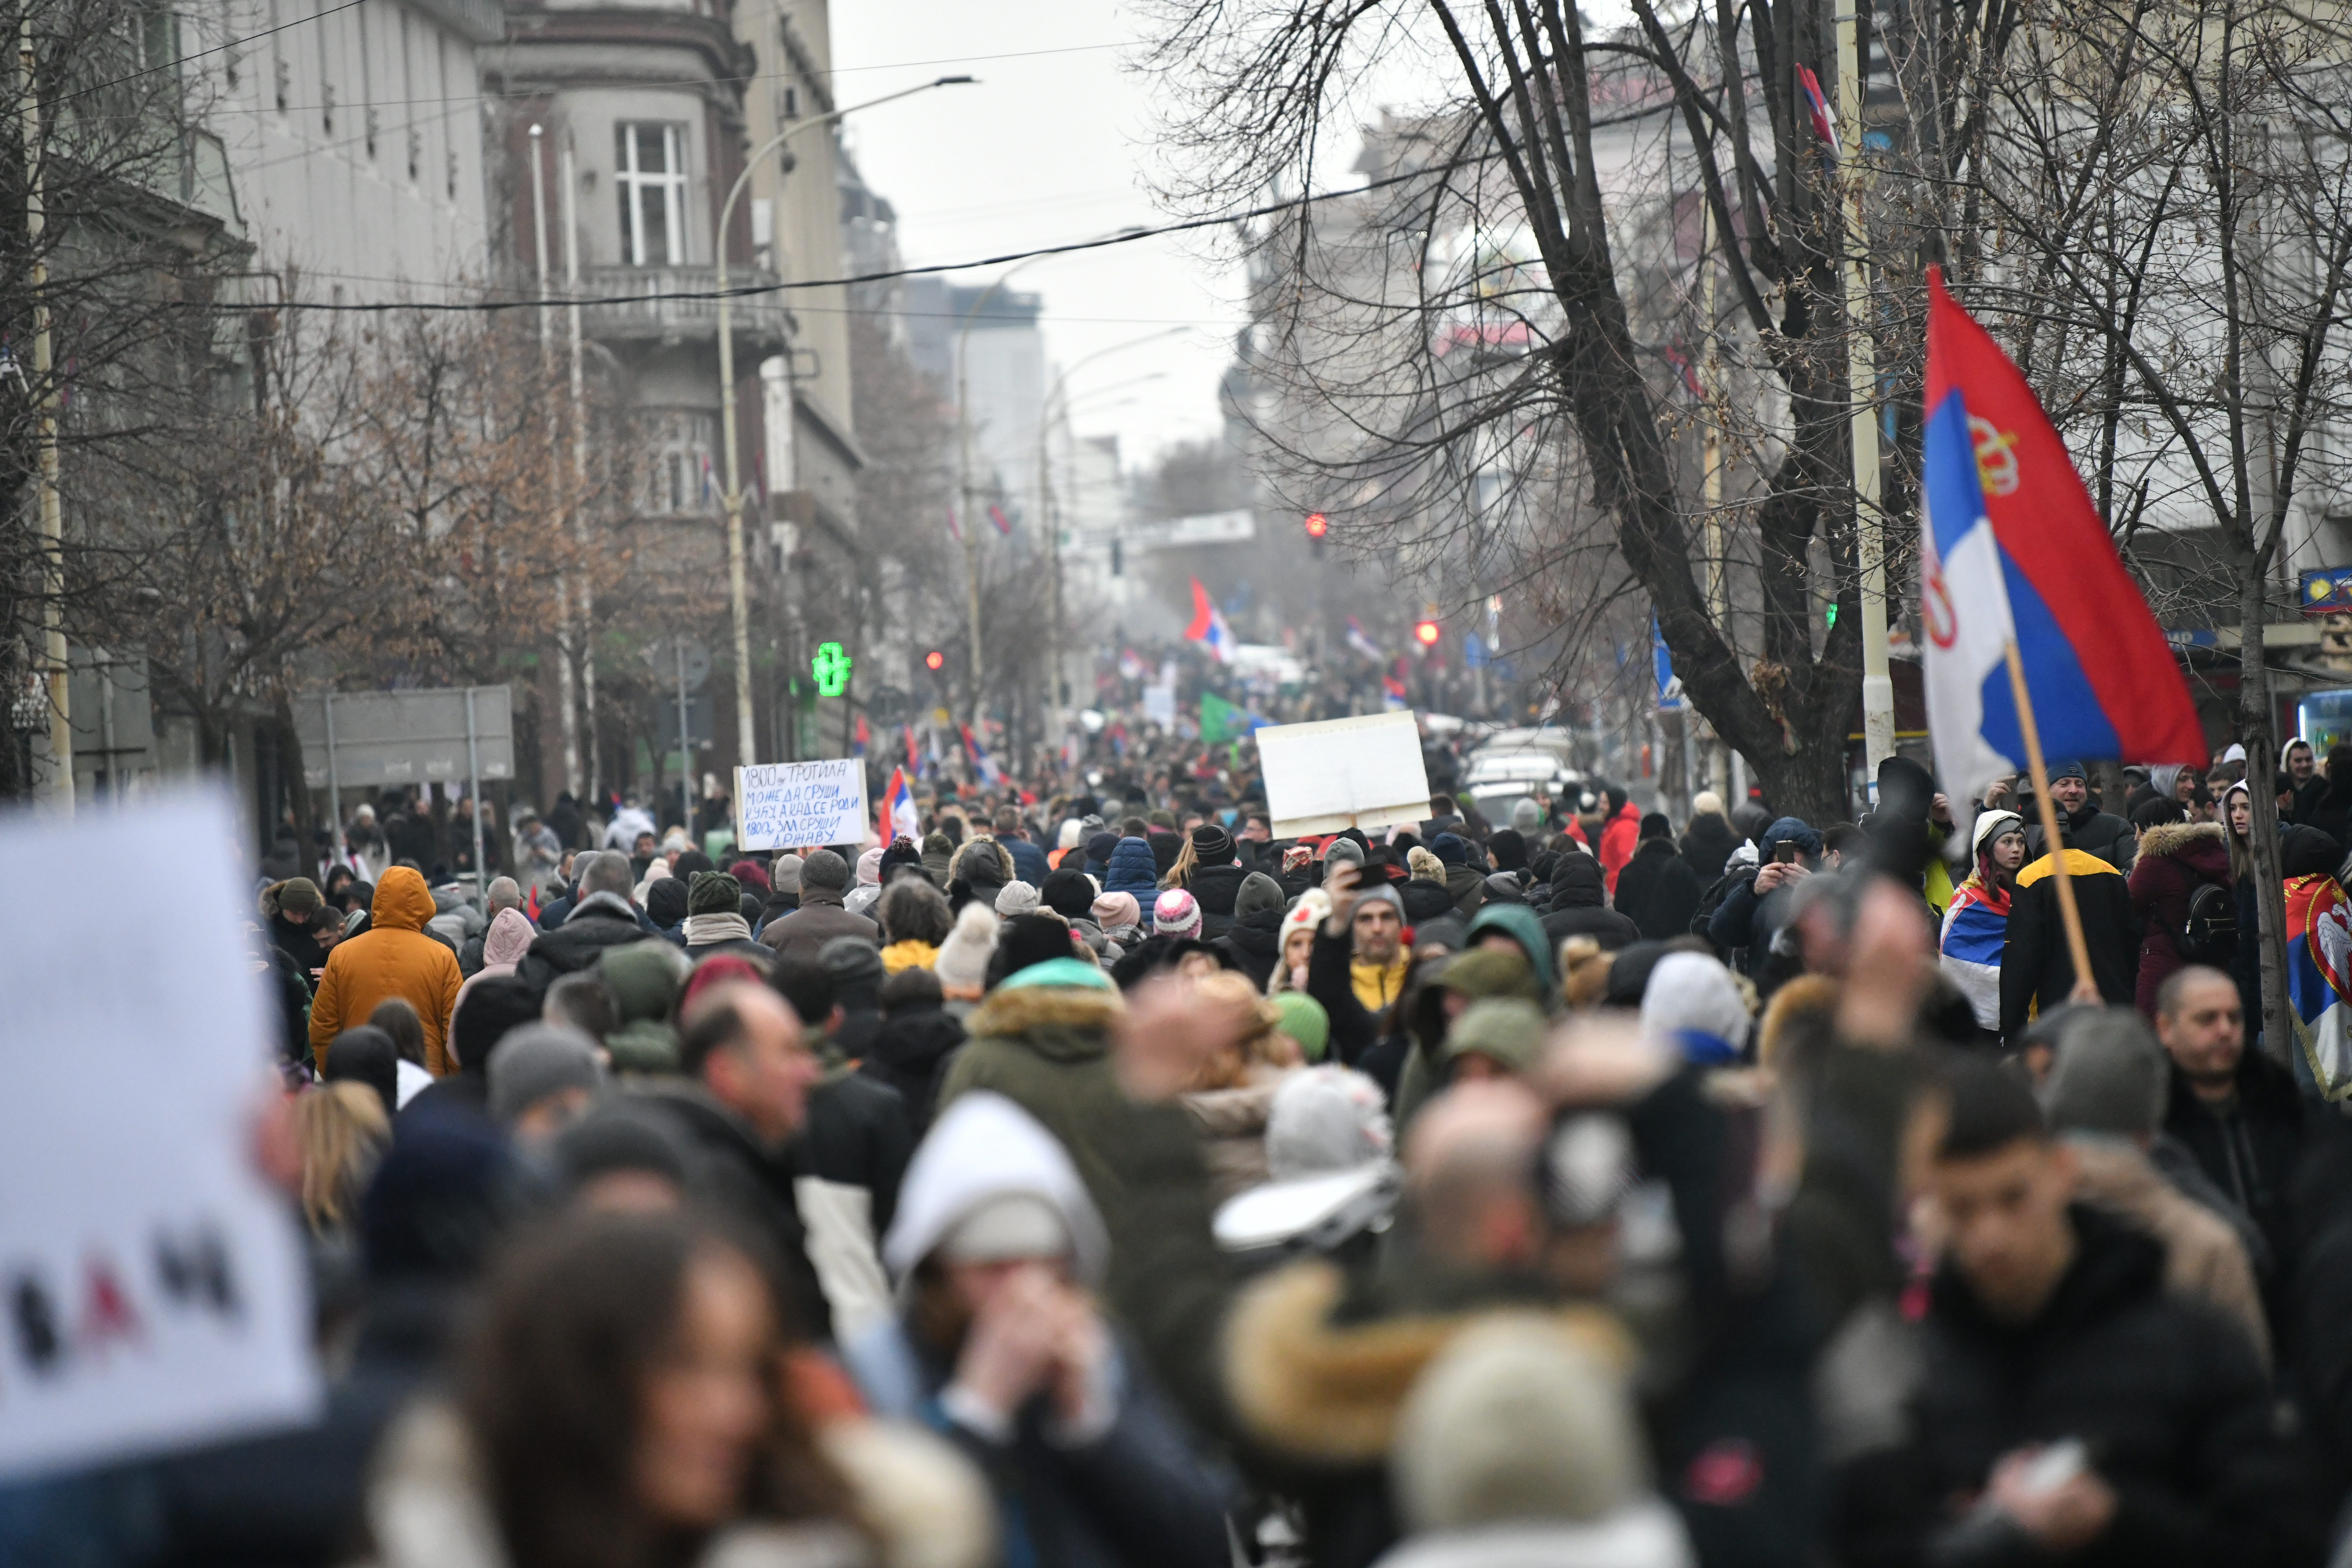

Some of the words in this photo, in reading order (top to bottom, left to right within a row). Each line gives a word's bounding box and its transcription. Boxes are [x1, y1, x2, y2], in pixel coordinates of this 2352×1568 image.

[787, 762, 847, 783] ТРОТИЛА
[745, 789, 783, 806] МОЖЕ
[782, 786, 800, 802] ДА
[804, 784, 839, 801] СРУШИ
[780, 804, 787, 818] А
[830, 797, 858, 813] РОДИ
[800, 816, 841, 831] СРУШИ
